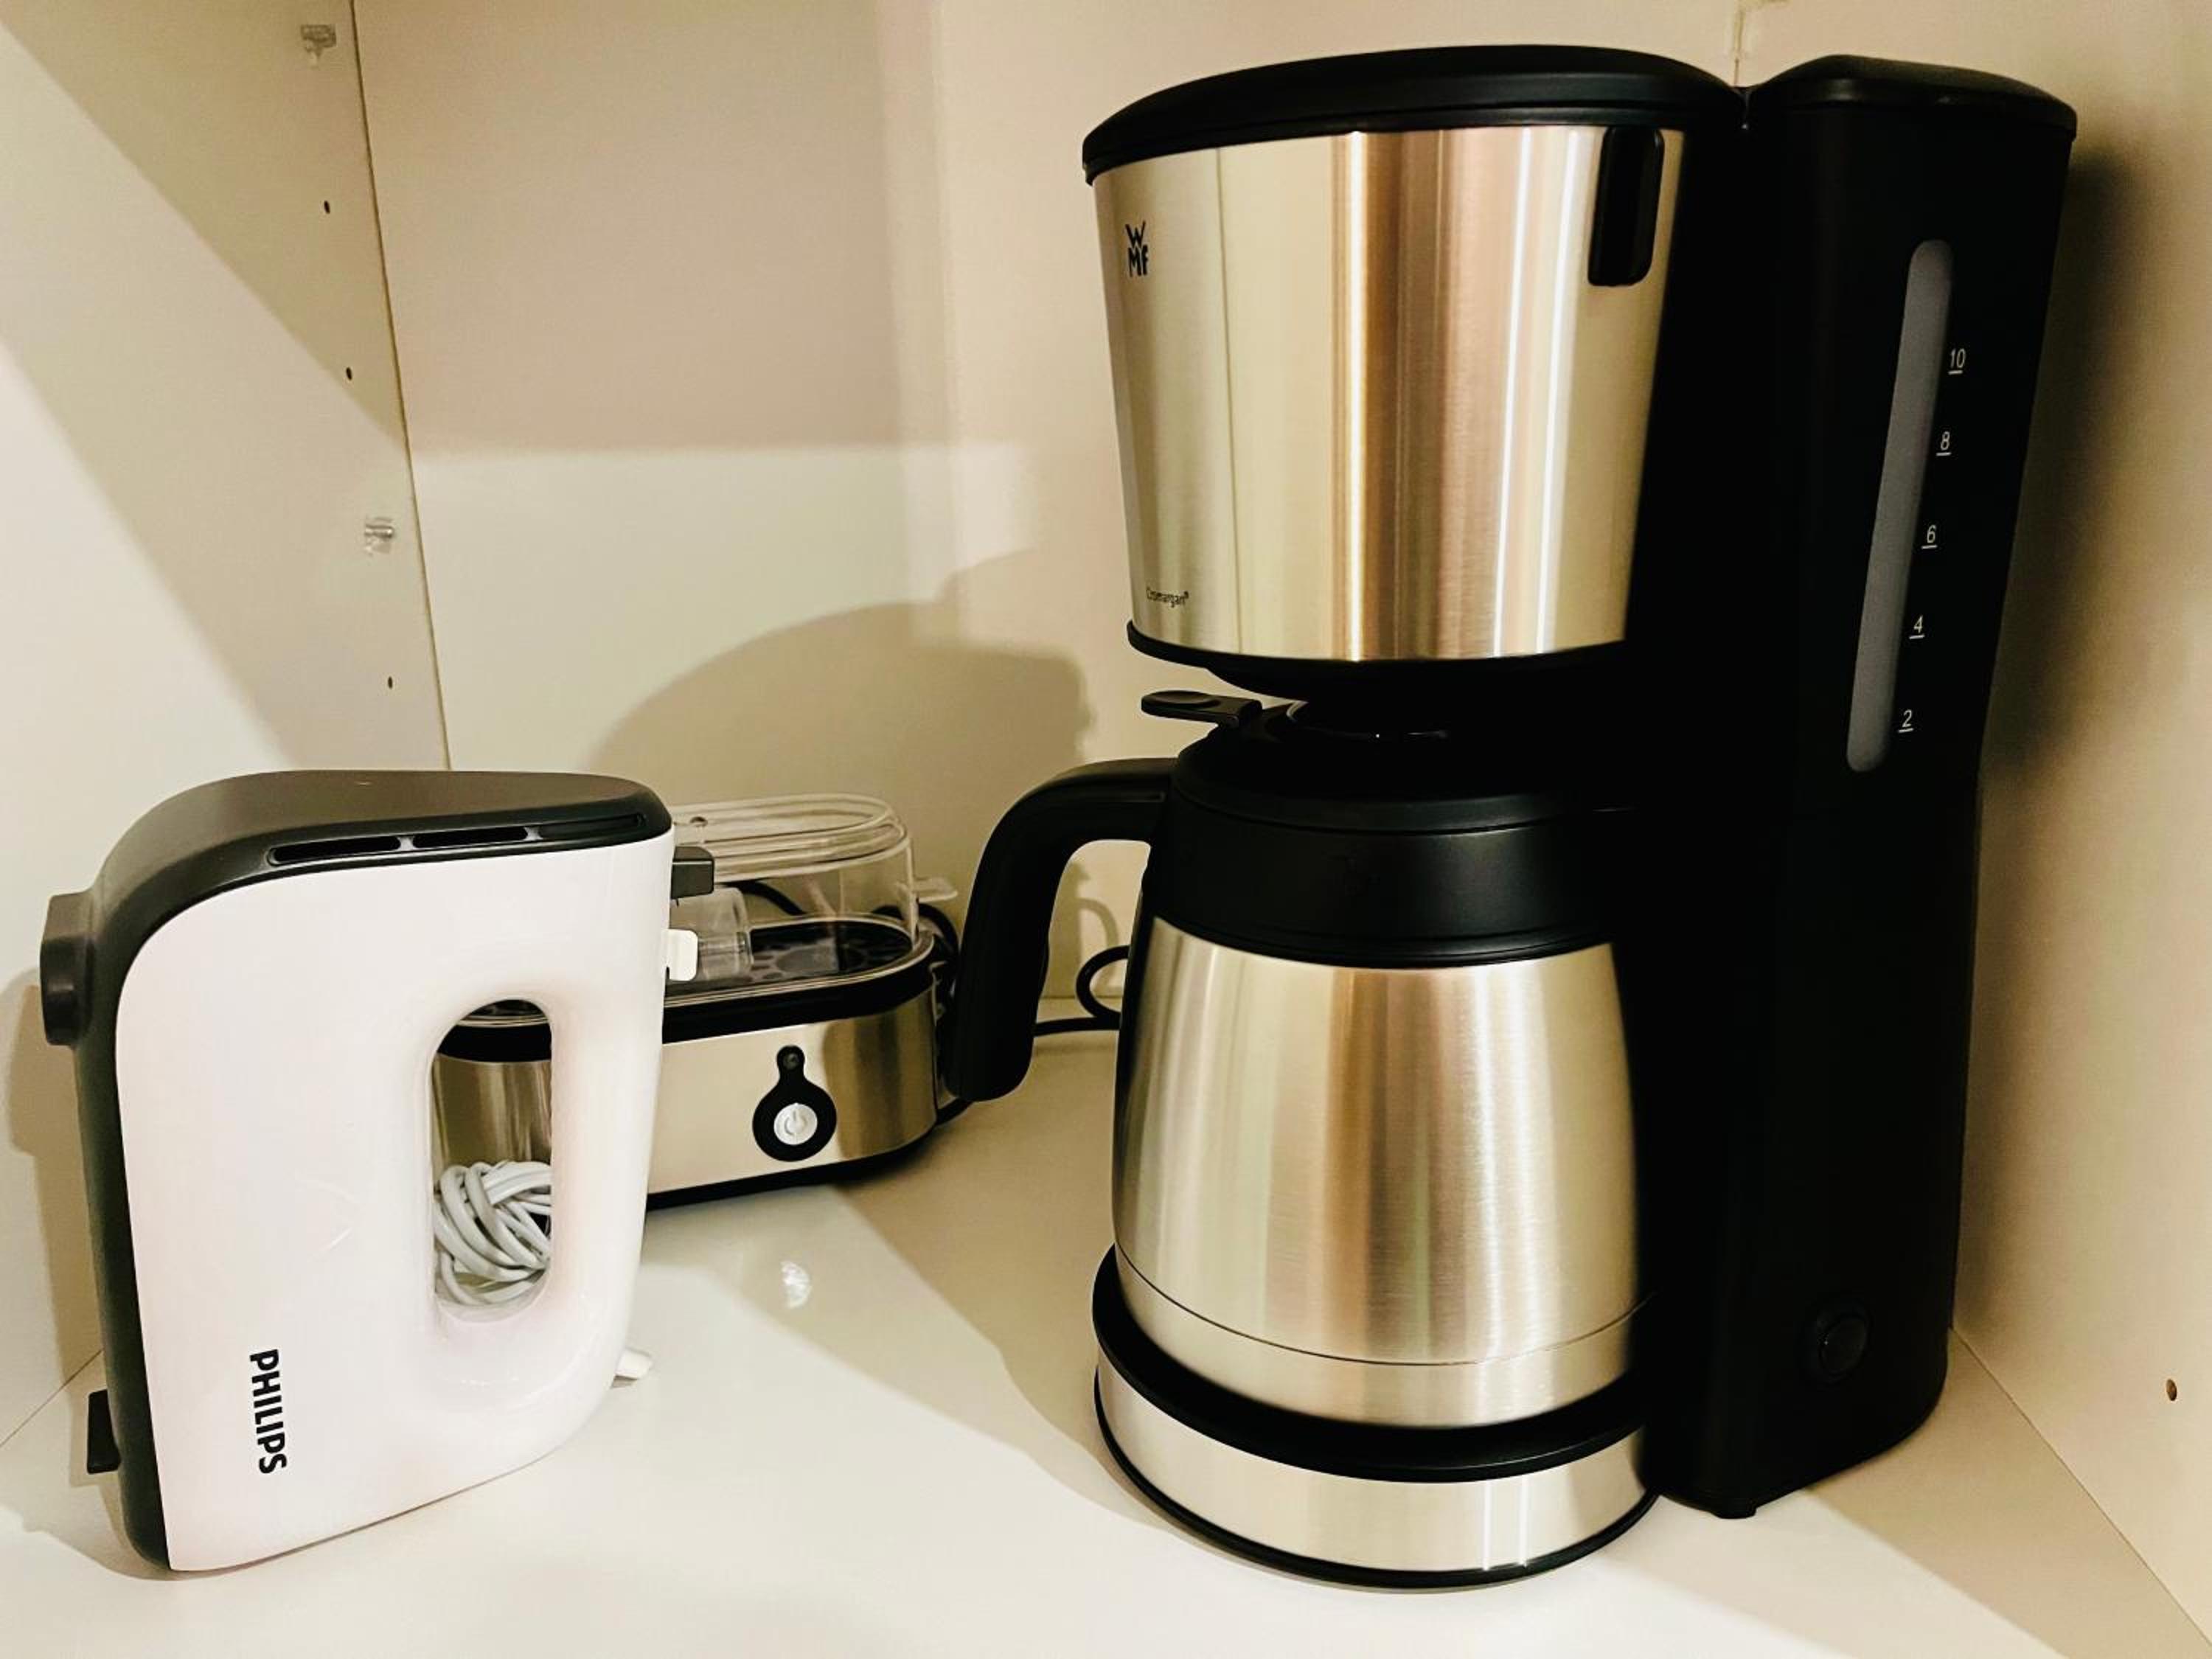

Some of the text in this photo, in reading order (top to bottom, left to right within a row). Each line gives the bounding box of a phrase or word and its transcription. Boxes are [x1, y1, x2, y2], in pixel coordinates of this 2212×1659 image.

[1950, 348, 1966, 369] 10
[1939, 431, 1950, 451] 8
[1926, 524, 1937, 543] 6
[1913, 615, 1924, 634] 4
[1901, 709, 1913, 728] 2
[250, 1349, 288, 1474] PHILIPS
